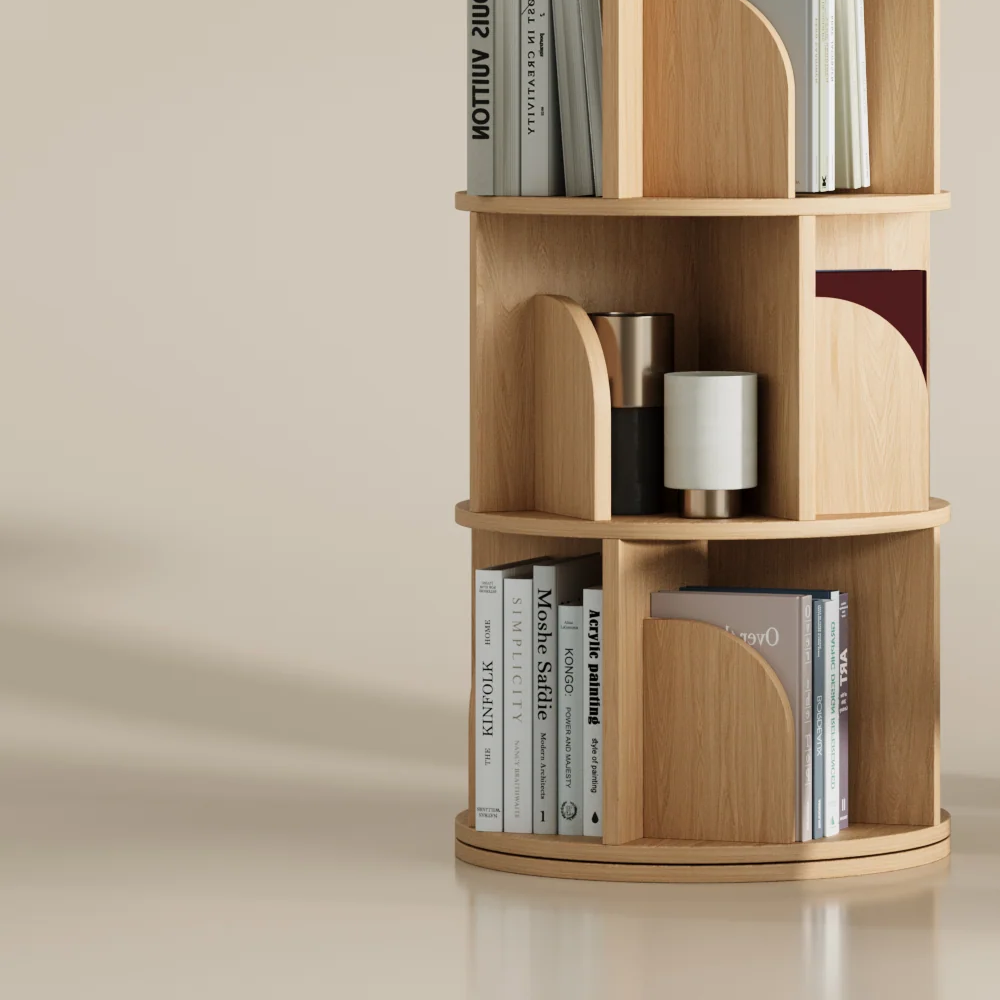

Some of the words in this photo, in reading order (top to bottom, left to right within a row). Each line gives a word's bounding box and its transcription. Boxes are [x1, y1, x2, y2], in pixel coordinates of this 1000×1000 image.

[538, 588, 552, 654] Moshe
[588, 609, 600, 660] Acrylic
[512, 597, 522, 724] SIMPLICITY
[564, 648, 574, 696] KONGO:
[482, 661, 494, 736] KINFOLK
[538, 661, 552, 720] Safdie
[588, 663, 600, 725] painting
[590, 738, 599, 754] style
[590, 765, 599, 794] painting
